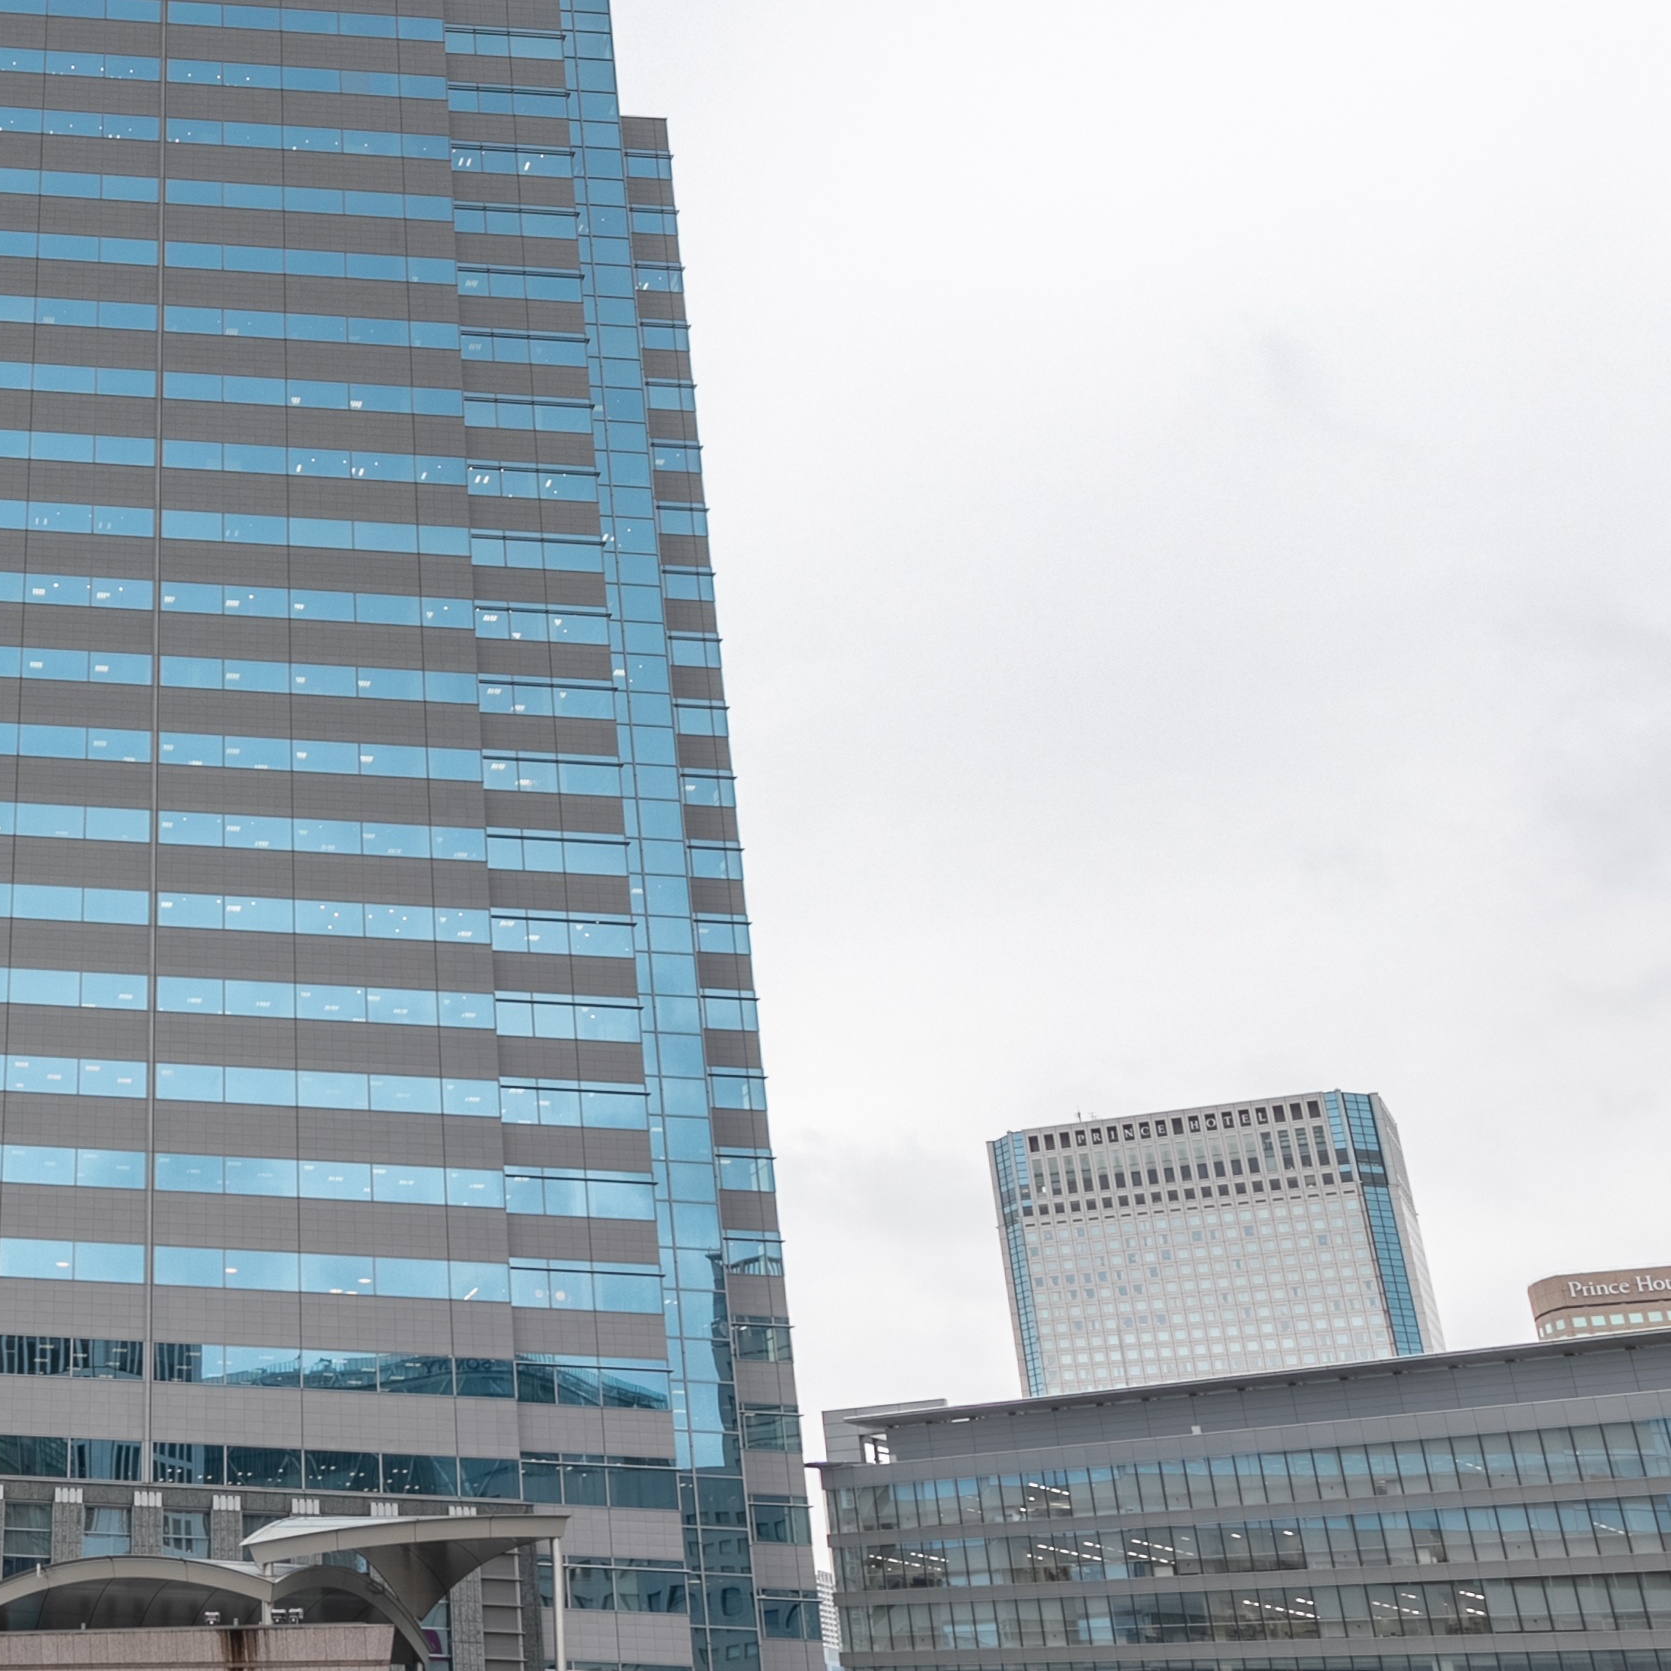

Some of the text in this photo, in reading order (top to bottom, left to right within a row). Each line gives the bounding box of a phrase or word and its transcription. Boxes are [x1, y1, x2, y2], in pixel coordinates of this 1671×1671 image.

[1077, 1111, 1267, 1144] PRINCE HOTEL
[1568, 1281, 1630, 1297] Prince
